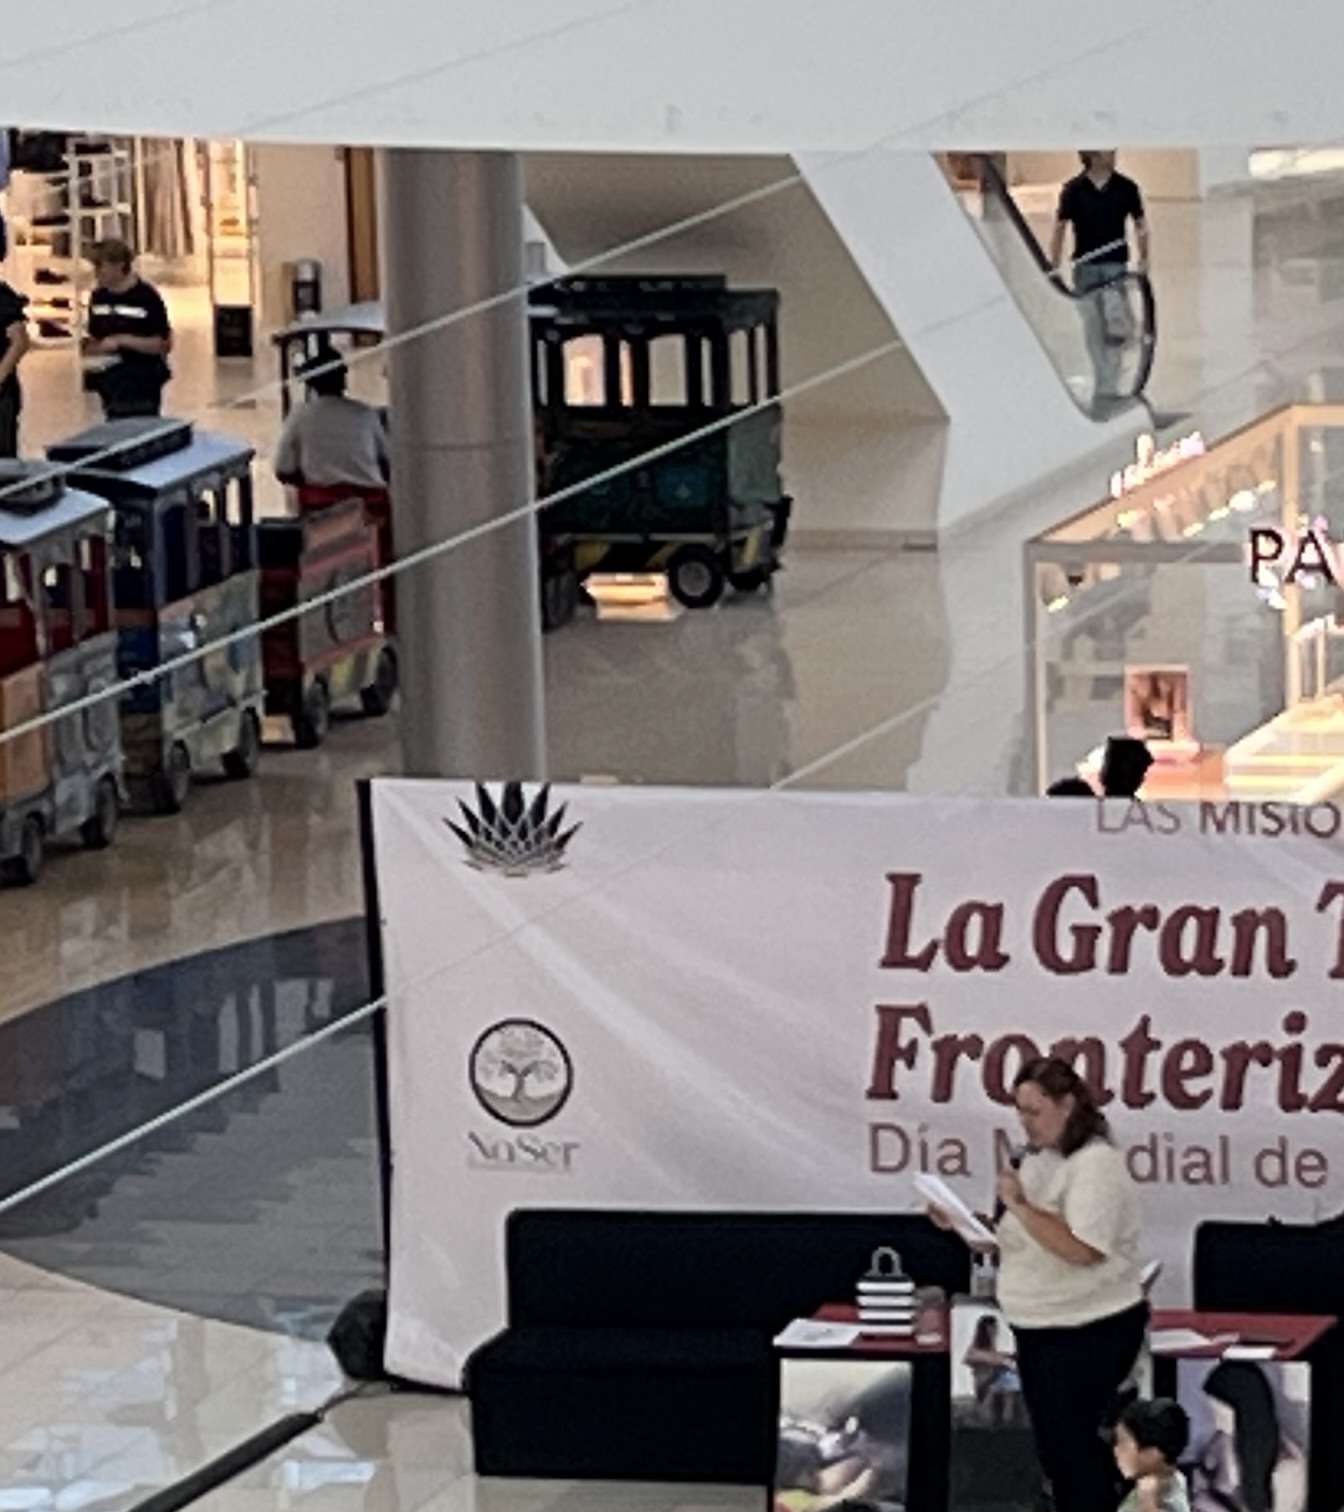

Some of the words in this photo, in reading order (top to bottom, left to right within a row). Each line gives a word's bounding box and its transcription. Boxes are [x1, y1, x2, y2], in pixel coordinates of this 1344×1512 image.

[1096, 799, 1181, 835] LAS
[879, 871, 1010, 972] La
[1032, 873, 1297, 978] Gran
[994, 1127, 1230, 1186] Mdial
[1254, 1136, 1328, 1188] de
